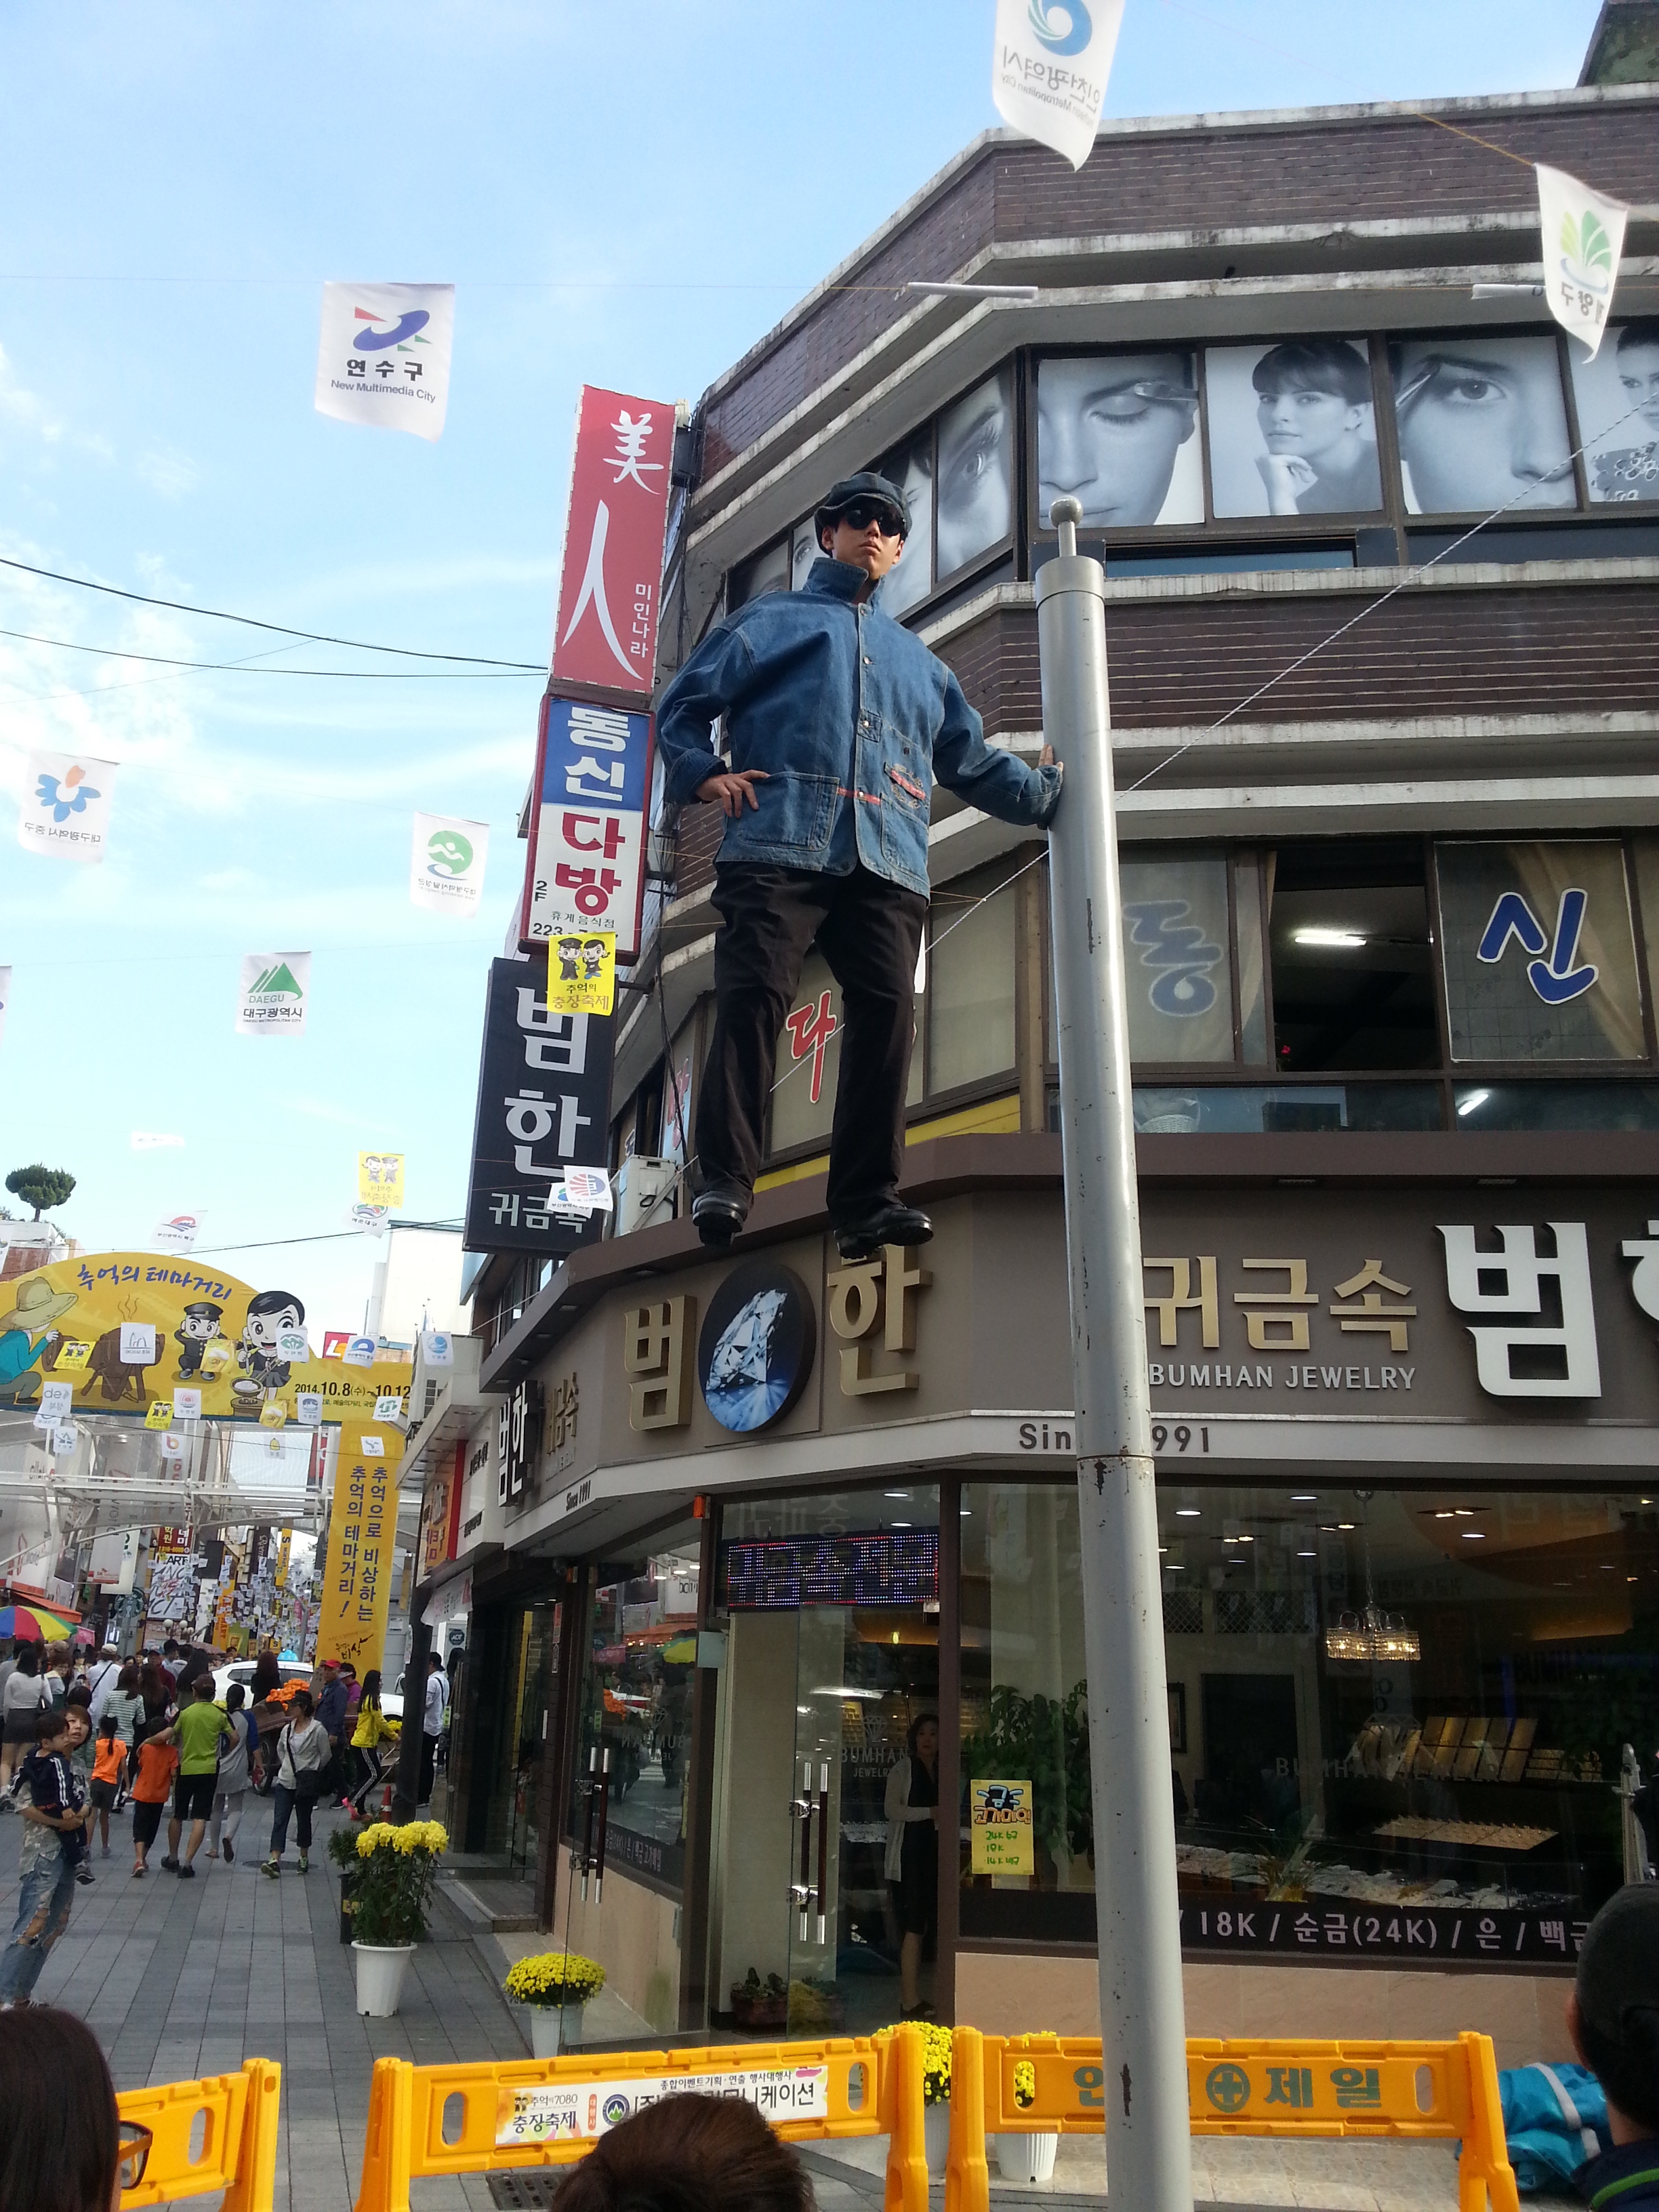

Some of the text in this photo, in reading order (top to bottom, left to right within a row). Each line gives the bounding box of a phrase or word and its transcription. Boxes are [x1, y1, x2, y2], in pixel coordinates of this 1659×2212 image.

[346, 359, 424, 382] 연수구
[331, 380, 436, 404] New Multimedia City
[630, 583, 652, 659] 미인나라
[551, 911, 615, 928] 휴게음식점
[249, 994, 285, 1004] DAEGU
[567, 983, 596, 994] 추억의
[243, 1007, 302, 1019] 대구광역시
[552, 994, 609, 1010] 충장축제
[504, 987, 591, 1178] 범한
[77, 1264, 232, 1300] 추억의 테마거리
[1142, 1256, 1417, 1351] 귀금속
[1149, 1364, 1416, 1389] BUMHAN JEWELRY
[1018, 1422, 1210, 1453] Sin 991
[347, 1466, 366, 1517] 추억의
[365, 1466, 388, 1538] 추억으로
[357, 1548, 379, 1622] 비상하는
[854, 1767, 892, 1777] JEWELR
[1200, 1910, 1257, 1938] 18K
[1293, 1912, 1437, 1948] 순금(24K)
[1475, 1920, 1502, 1950] 은
[749, 2070, 792, 2084] 행사대행사
[512, 2110, 577, 2134] 충장축제
